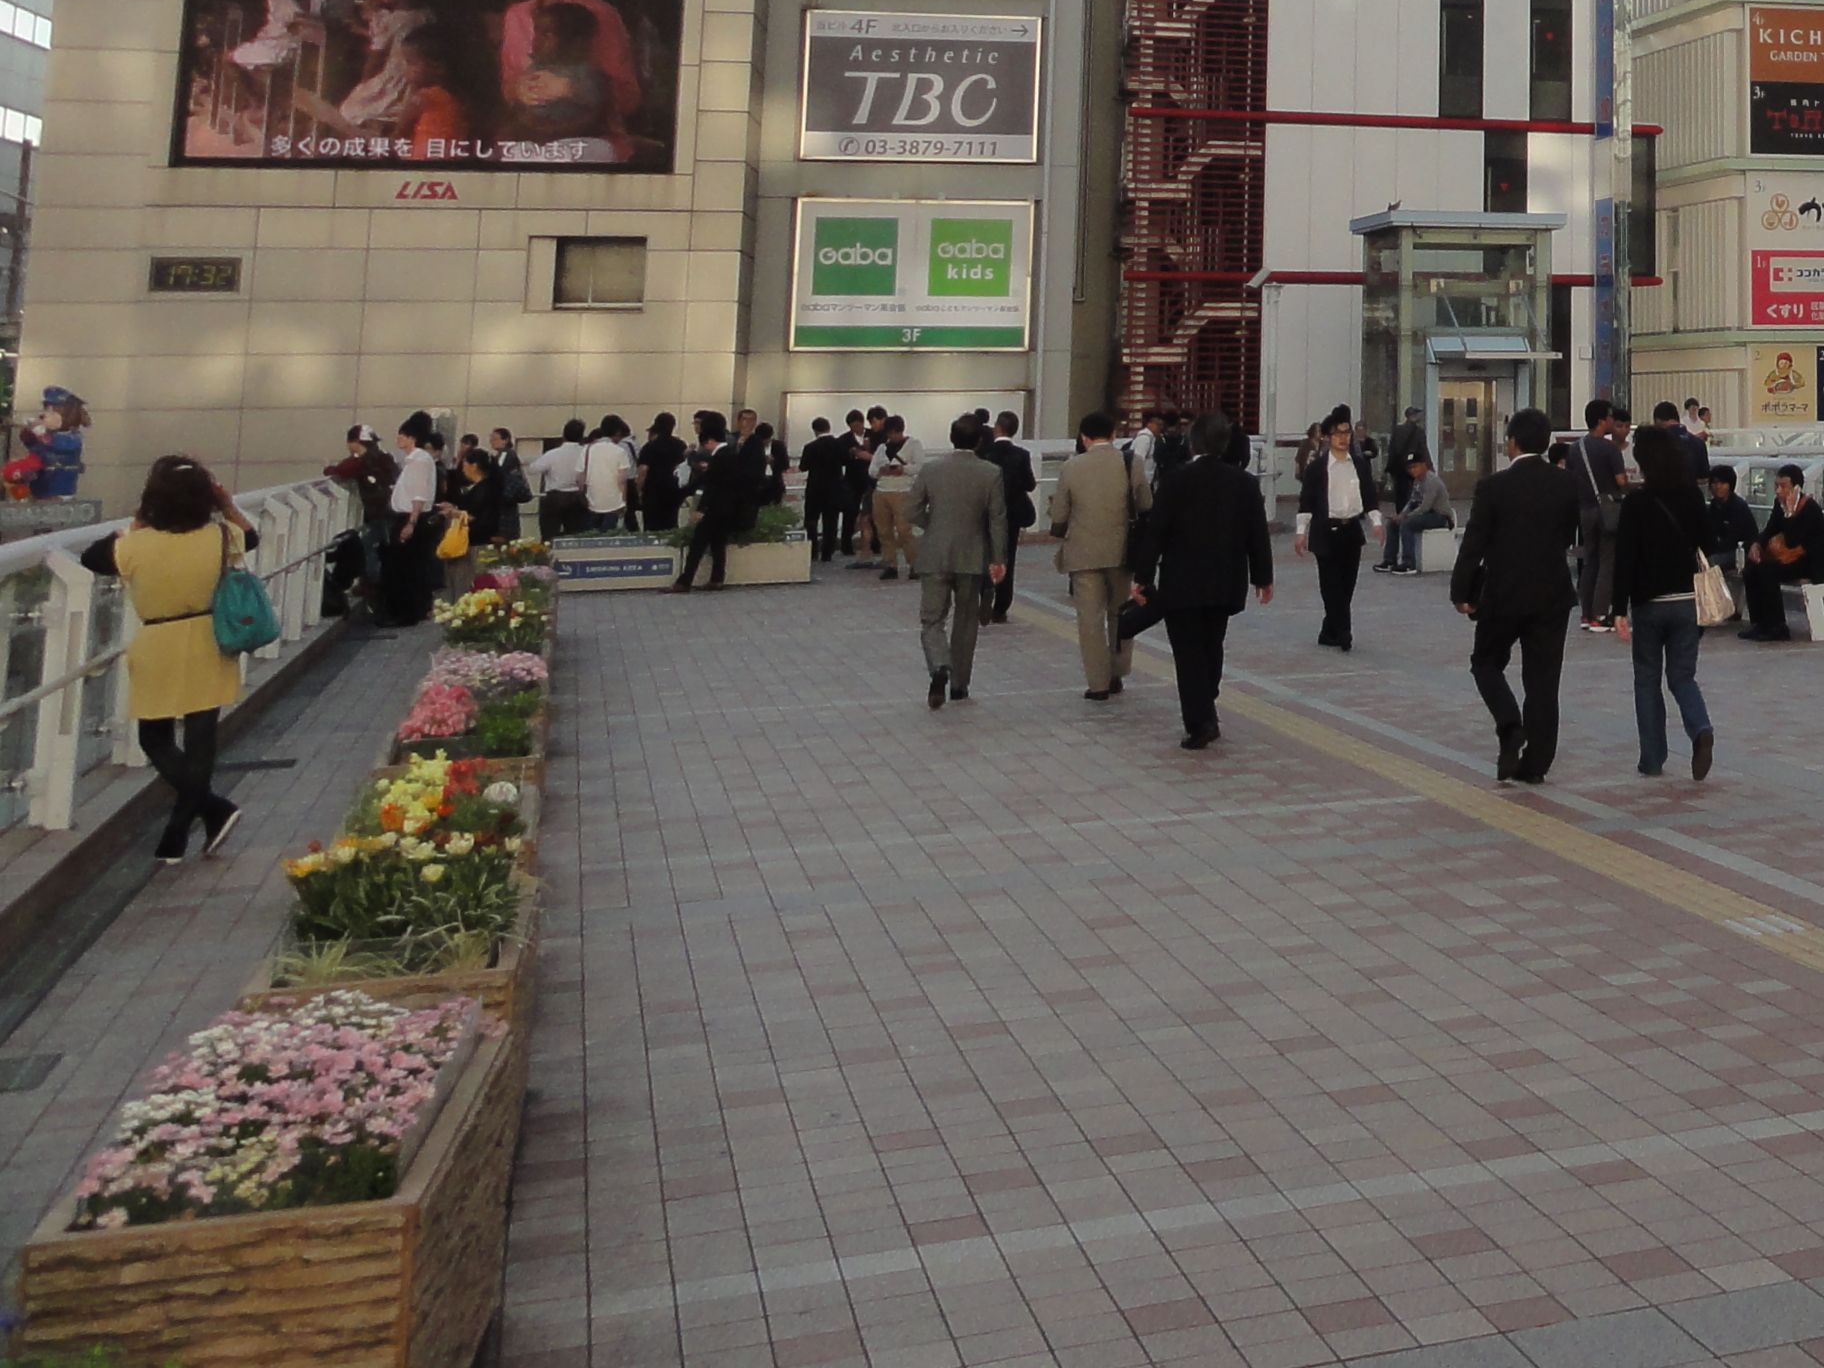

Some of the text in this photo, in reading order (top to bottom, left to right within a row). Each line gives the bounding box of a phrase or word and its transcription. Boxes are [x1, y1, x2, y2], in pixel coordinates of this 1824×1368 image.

[850, 19, 878, 34] 4F
[849, 44, 1000, 64] Aesthetic
[1770, 50, 1817, 62] GARDEN
[844, 72, 997, 127] TBC
[271, 135, 588, 160] 多くの成果を 目にしています
[865, 139, 998, 156] 03-3879-7111
[395, 181, 459, 200] LISA
[947, 263, 994, 280] kids
[1767, 303, 1803, 318] くすり
[902, 328, 921, 343] 3F
